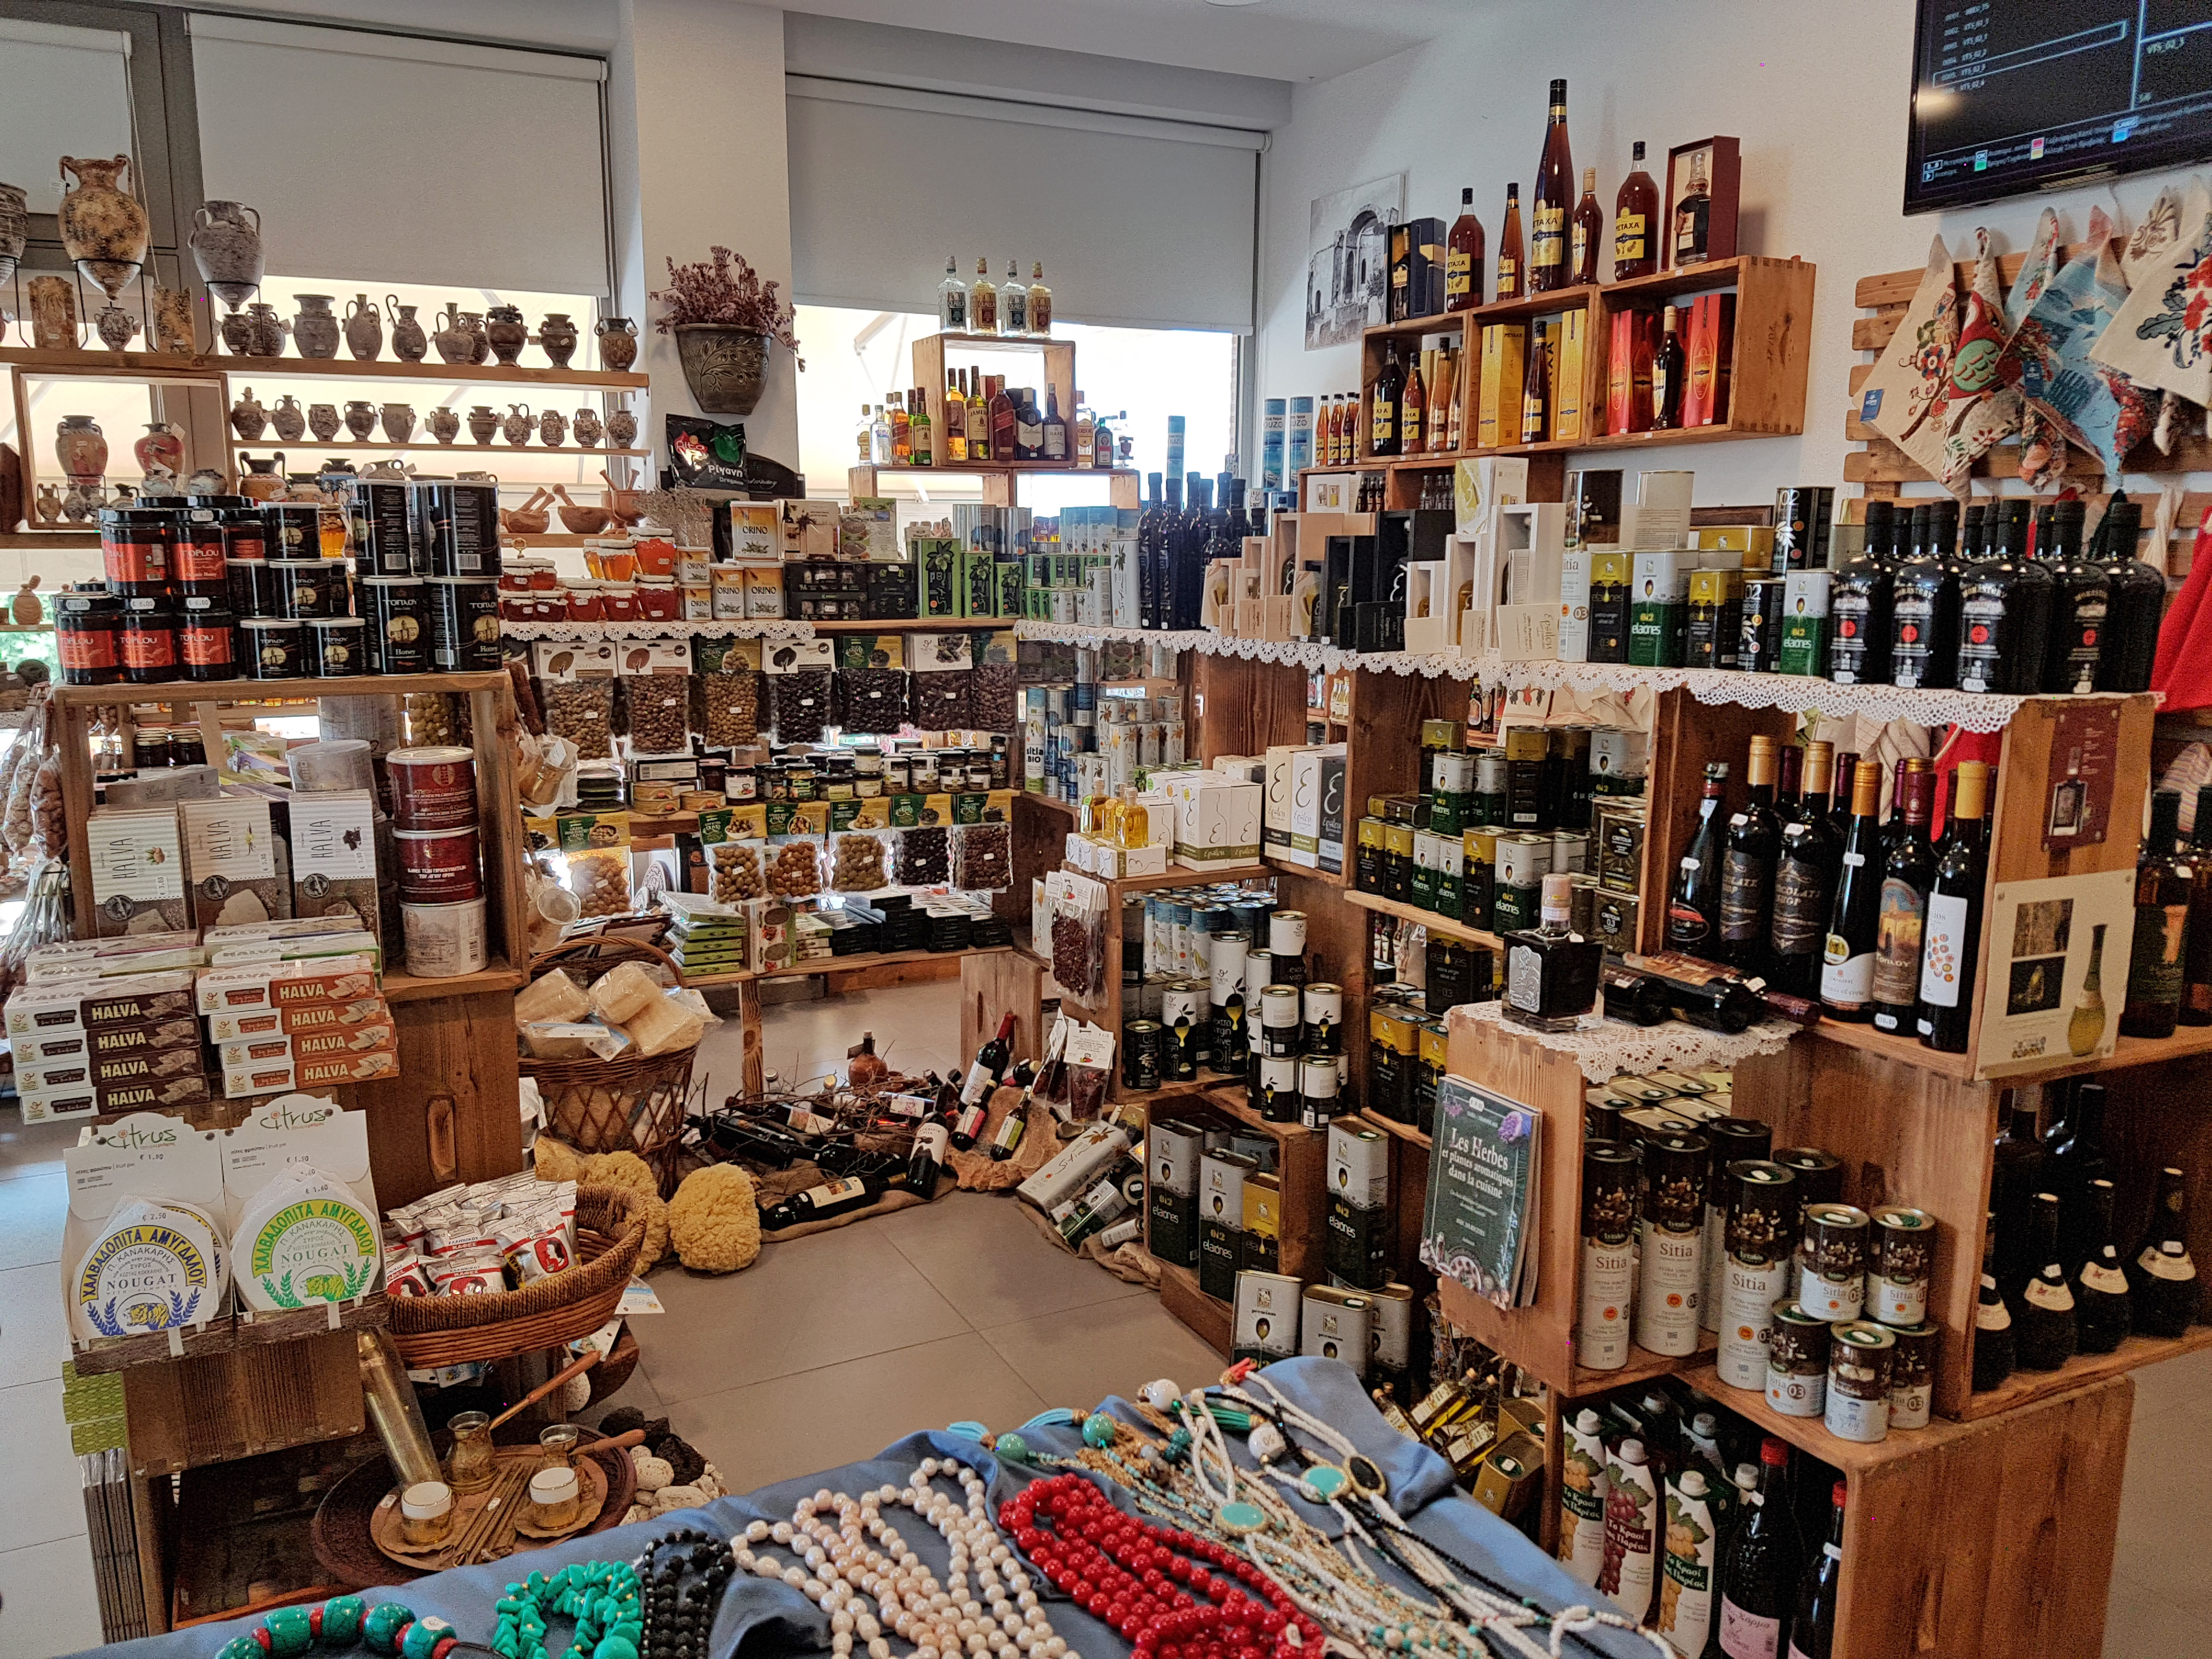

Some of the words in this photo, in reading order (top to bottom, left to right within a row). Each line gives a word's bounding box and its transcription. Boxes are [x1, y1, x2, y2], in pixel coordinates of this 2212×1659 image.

[1781, 489, 1800, 506] 02
[742, 526, 768, 535] ORINO
[718, 586, 740, 595] ORINO
[751, 586, 776, 595] ORINO
[1745, 584, 1762, 600] 02
[1575, 608, 1589, 618] 03
[207, 820, 233, 860] HALVA
[309, 820, 333, 859] HALVA
[110, 837, 138, 879] HALVA
[280, 983, 325, 1000] HALVA
[92, 1002, 141, 1020] HALVA
[291, 1009, 336, 1026] HALVA
[1213, 1018, 1232, 1026] extra
[98, 1031, 146, 1049] HALVA
[302, 1035, 346, 1053] HALVA
[100, 1060, 149, 1079] HALVA
[304, 1063, 348, 1080] HALVA
[108, 1088, 155, 1107] HALVA
[260, 1104, 326, 1130] citrus
[108, 1123, 177, 1149] citrus
[1449, 1127, 1469, 1153] Les
[1471, 1136, 1508, 1171] Herbes
[1442, 1149, 1449, 1158] et
[1449, 1150, 1473, 1169] plantes
[1474, 1163, 1514, 1188] aromatiques
[1448, 1164, 1466, 1182] dans
[1466, 1171, 1475, 1186] la
[1476, 1179, 1503, 1199] cuisine
[150, 1212, 167, 1221] 2.50
[255, 1203, 314, 1272] ΧΑΛΒΑΔΟΠΙΤΑ
[320, 1203, 374, 1257] ΑΜΥΓΔΑΛΟΥ
[290, 1220, 347, 1238] ΚΑΝΑΚΑΡΗΣ
[117, 1246, 176, 1265] ΚΑΝΑΚΑΡΗΣ
[281, 1244, 349, 1264] NOUGAT
[1660, 1243, 1693, 1257] Sitia
[82, 1228, 143, 1298] ΧΑΛΒΑΔΟΠΙΤΑ
[149, 1228, 206, 1285] ΑΜΥΓΔΑΛΟΥ
[1595, 1256, 1628, 1269] Sitia
[106, 1273, 177, 1290] NOUGAT
[1733, 1273, 1766, 1291] Sitia
[1824, 1287, 1847, 1297] Sitia
[1889, 1290, 1913, 1300] Sitia
[1789, 1386, 1805, 1396] 03
[1573, 1491, 1596, 1508] Κρασί
[1607, 1519, 1618, 1530] Το
[1620, 1523, 1645, 1540] Κρασί
[1617, 1533, 1649, 1551] Παρέας
[1666, 1553, 1675, 1564] Το
[1677, 1559, 1702, 1577] Κρασί
[1673, 1568, 1705, 1588] Παρέας
